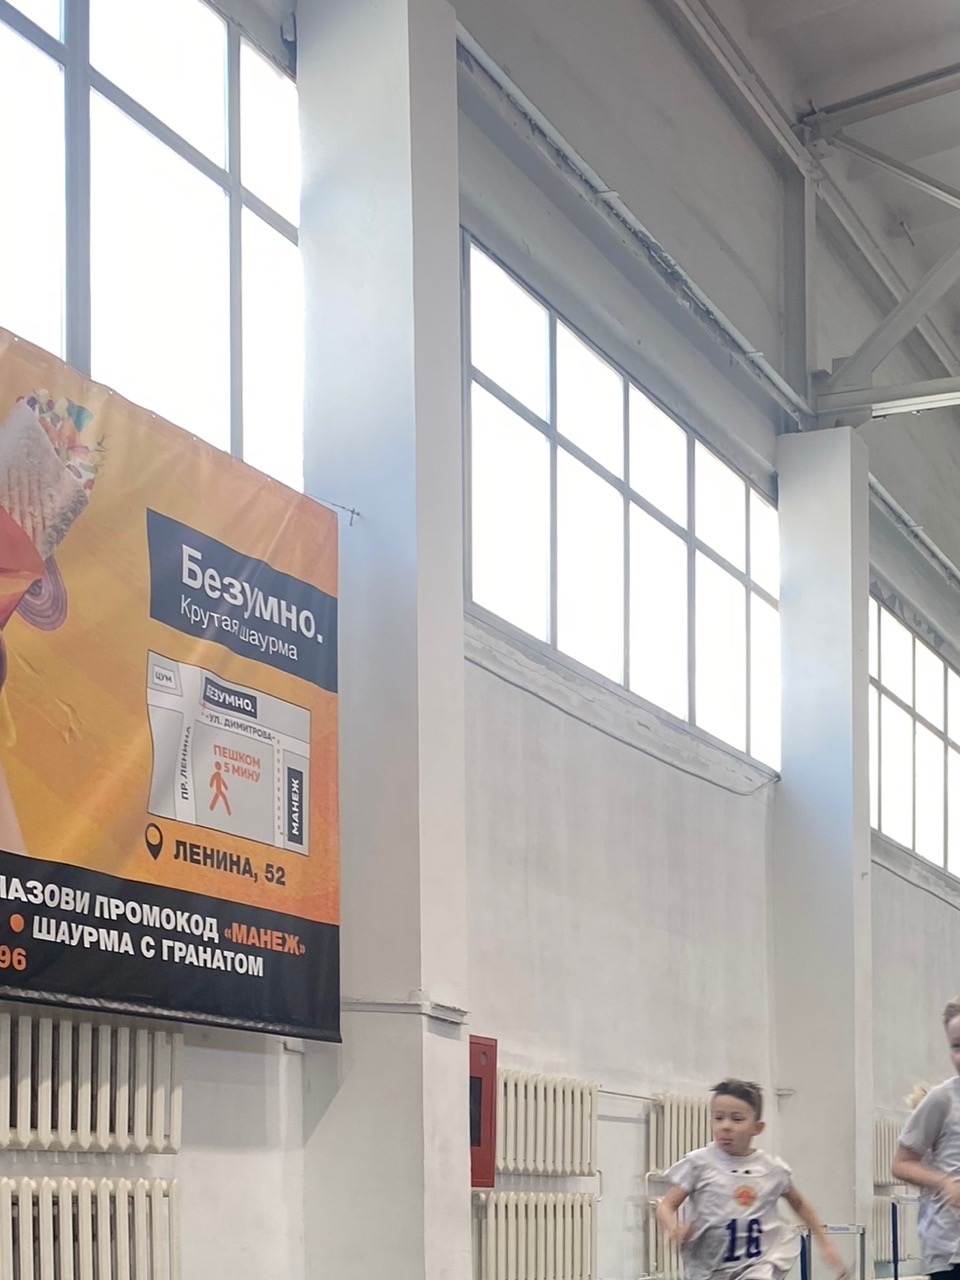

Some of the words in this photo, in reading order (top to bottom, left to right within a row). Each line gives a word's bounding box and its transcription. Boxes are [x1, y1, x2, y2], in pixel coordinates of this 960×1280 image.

[182, 544, 323, 643] Безумно.
[181, 594, 239, 635] Крутая
[239, 626, 298, 660] шаурма
[155, 671, 172, 684] ЦУМ
[179, 726, 191, 779] ЛЕНИНА
[213, 744, 260, 769] ПЕШКОМ
[224, 762, 230, 773] 5
[180, 781, 189, 801] ПР.
[291, 777, 300, 836] МАНЕЖ
[173, 839, 258, 883] ЛЕНИНА,
[265, 863, 285, 886] 52
[32, 915, 135, 955] ШАУРМА
[140, 935, 156, 958] С
[162, 939, 263, 977] ГРАНАТОМ
[94, 895, 219, 943] ПРОМОКОД
[224, 922, 306, 955] «МАНЕЖ»
[723, 1218, 763, 1263] 16
